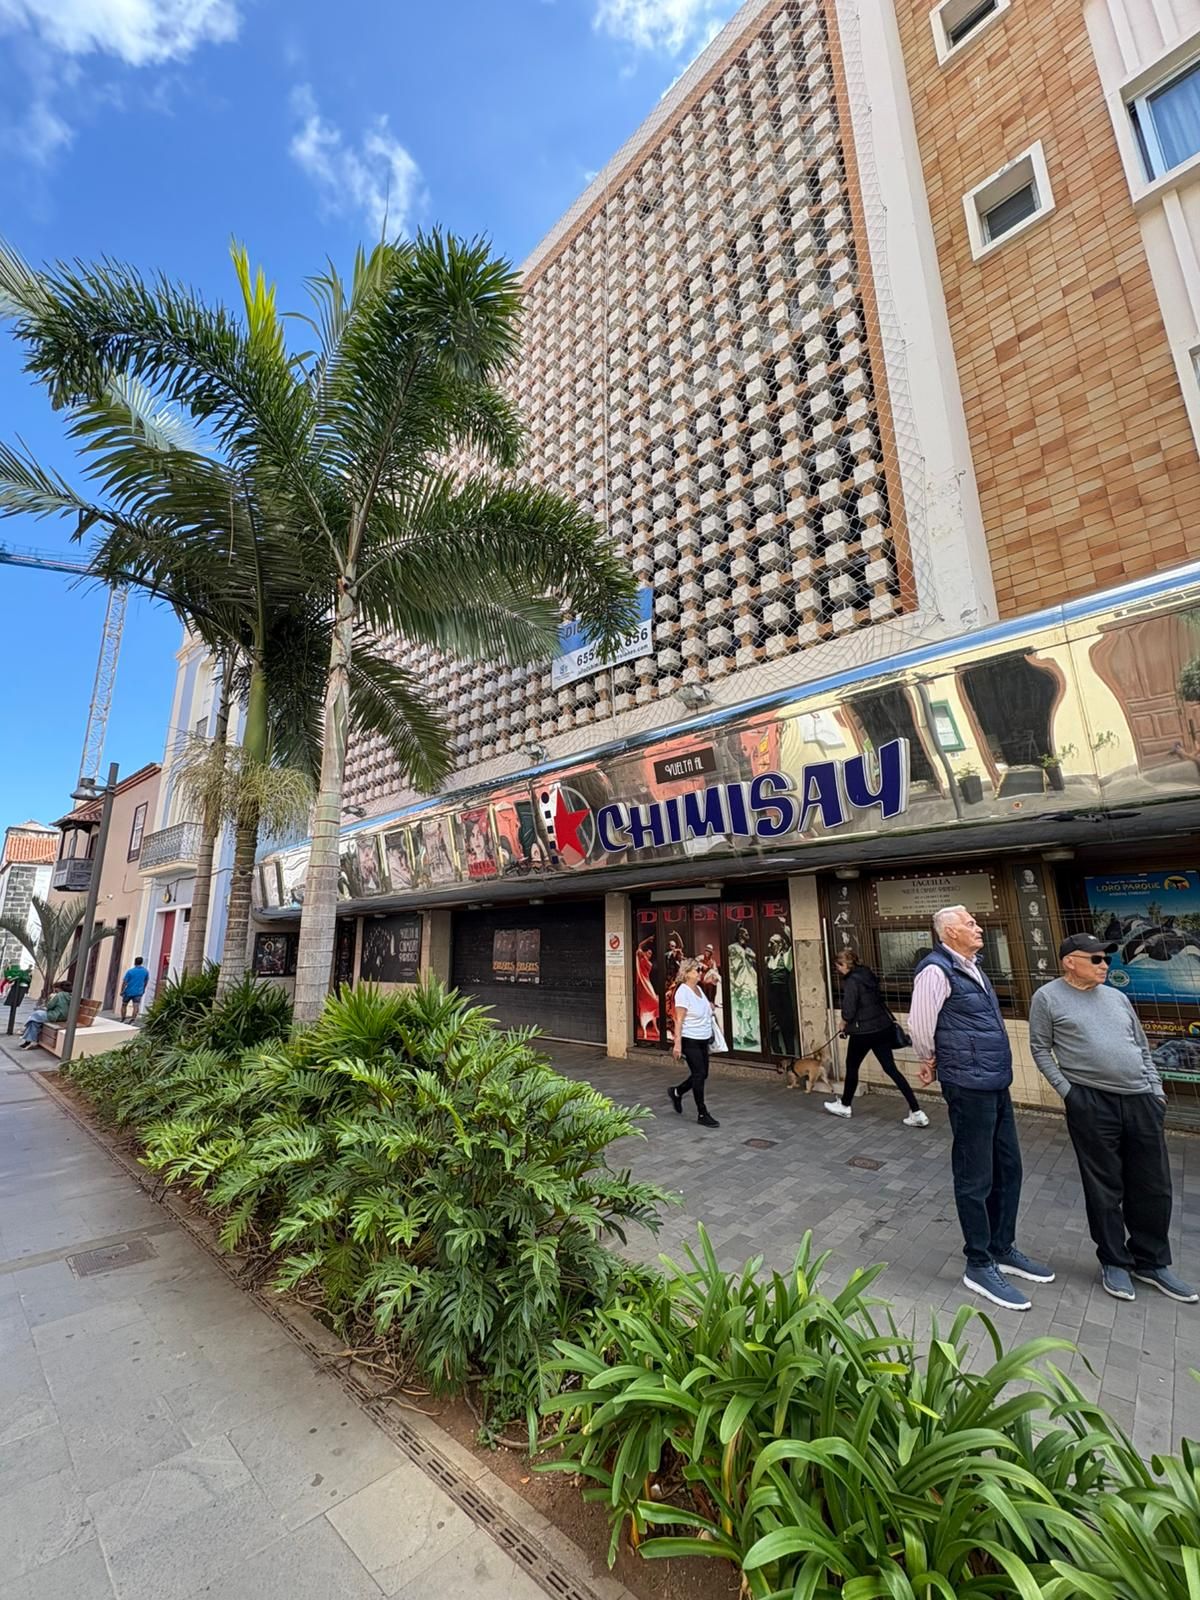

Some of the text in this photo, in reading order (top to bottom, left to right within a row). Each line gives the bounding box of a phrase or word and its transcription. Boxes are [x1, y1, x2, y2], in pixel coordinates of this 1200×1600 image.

[576, 648, 595, 667] 655
[664, 756, 705, 777] VUELTA AL
[596, 737, 909, 854] CHIMISAY
[1096, 881, 1161, 893] LORO PARQUE
